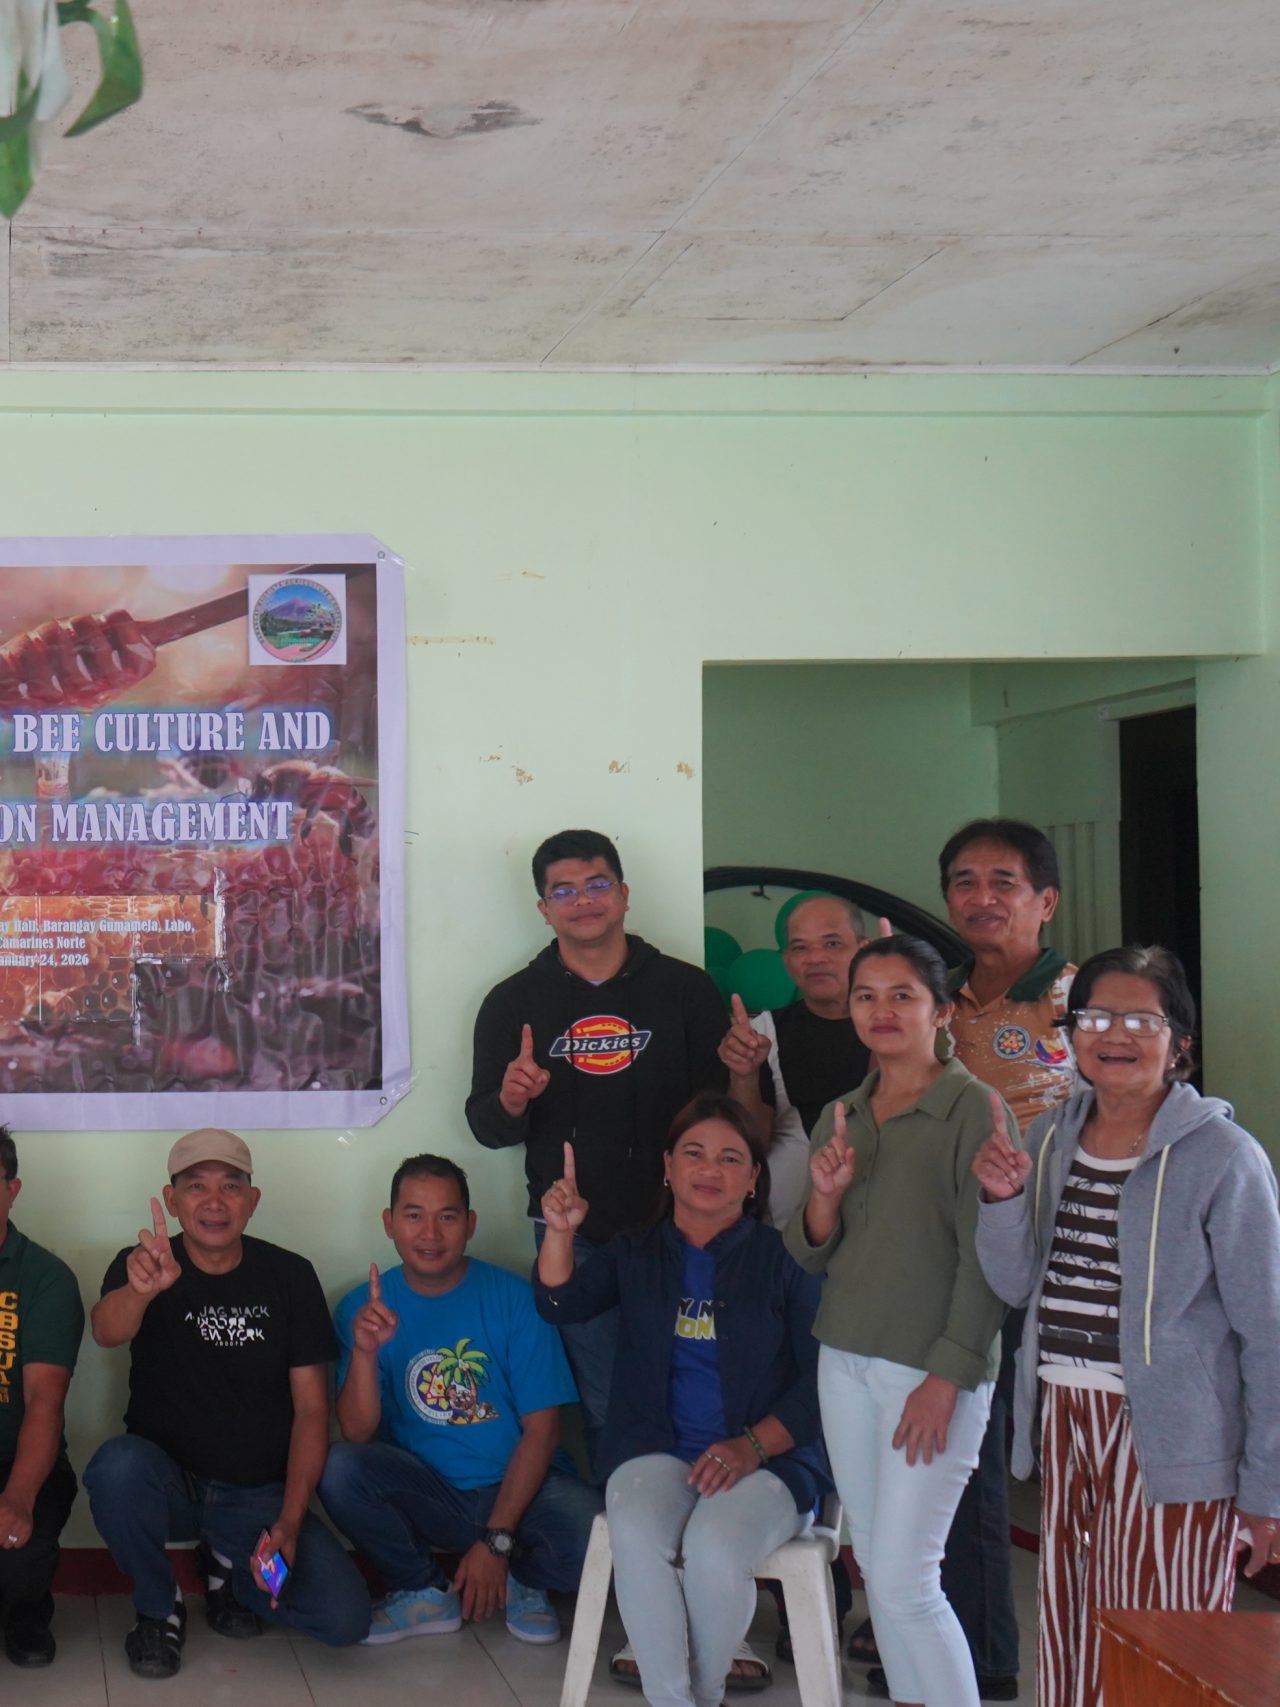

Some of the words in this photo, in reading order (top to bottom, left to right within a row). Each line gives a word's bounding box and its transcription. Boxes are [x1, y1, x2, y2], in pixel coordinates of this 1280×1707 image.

[12, 712, 82, 752] BEE
[94, 711, 246, 751] CULTURE
[258, 710, 332, 750] AND
[51, 800, 294, 841] MANAGEMENT
[43, 919, 96, 934] Barangay
[165, 919, 195, 932] Labo,
[56, 936, 86, 949] Norte
[38, 954, 58, 967] 24,
[61, 953, 89, 966] 2026
[562, 1037, 642, 1052] Dickies
[199, 1305, 228, 1318] JAG
[227, 1328, 265, 1341] YORK
